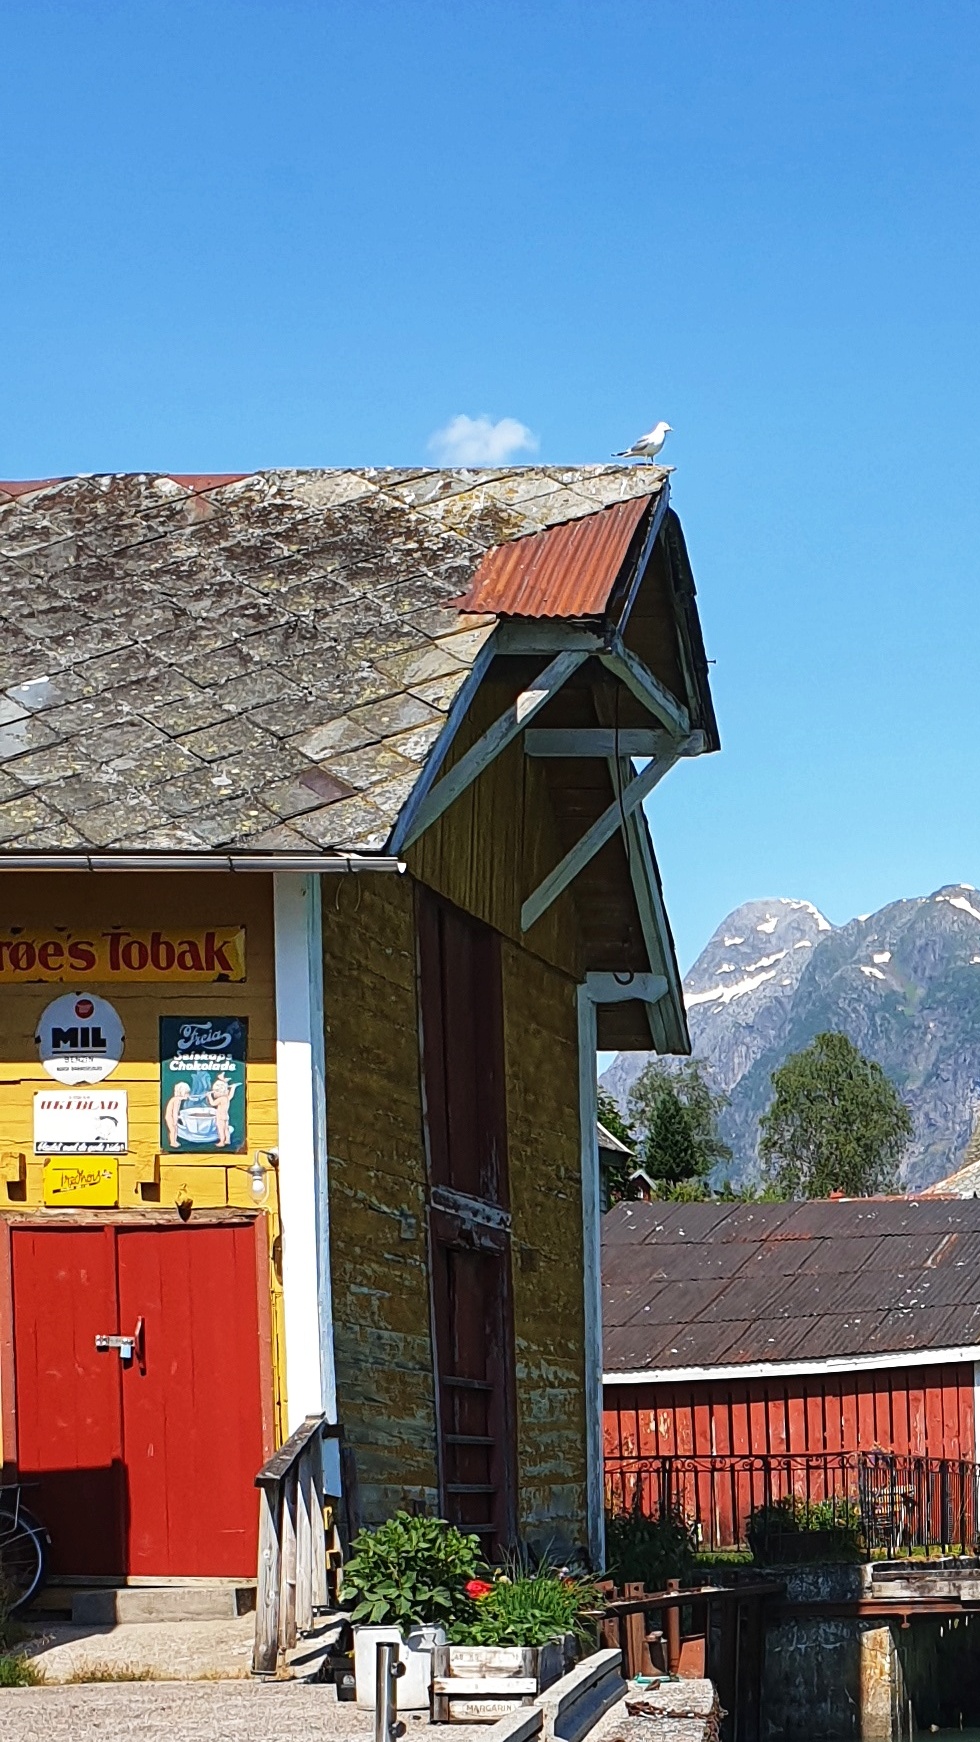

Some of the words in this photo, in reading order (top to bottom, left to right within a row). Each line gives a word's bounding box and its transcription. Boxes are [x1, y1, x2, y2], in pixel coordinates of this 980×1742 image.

[101, 931, 235, 972] Tobak
[52, 1027, 106, 1048] MIL
[177, 1021, 232, 1050] Freia
[169, 1059, 237, 1071] Chokolade
[466, 1704, 512, 1713] MARGARIN
